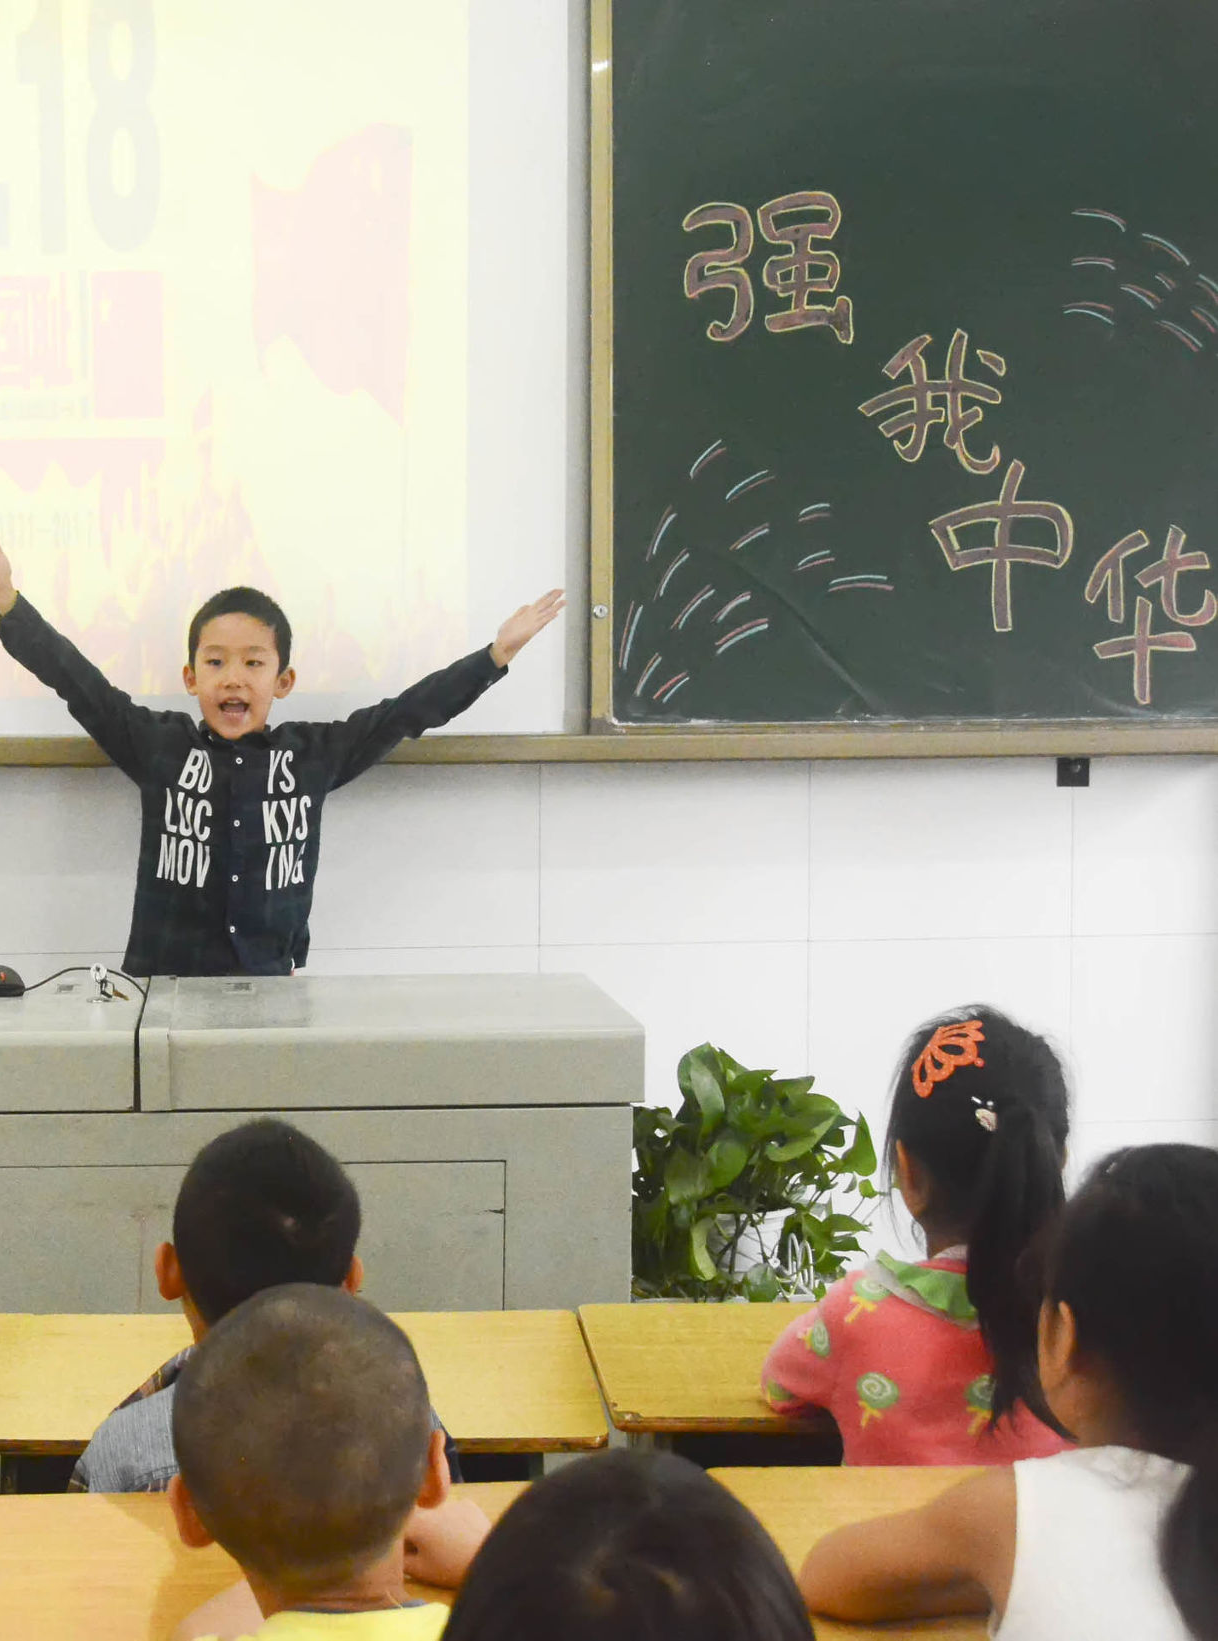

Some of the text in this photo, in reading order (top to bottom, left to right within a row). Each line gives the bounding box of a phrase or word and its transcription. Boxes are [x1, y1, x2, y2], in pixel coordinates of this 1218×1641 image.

[681, 190, 1218, 705] 强我中华
[267, 750, 296, 794] YS
[164, 788, 312, 844] LUC KYS
[156, 834, 211, 888] MOV
